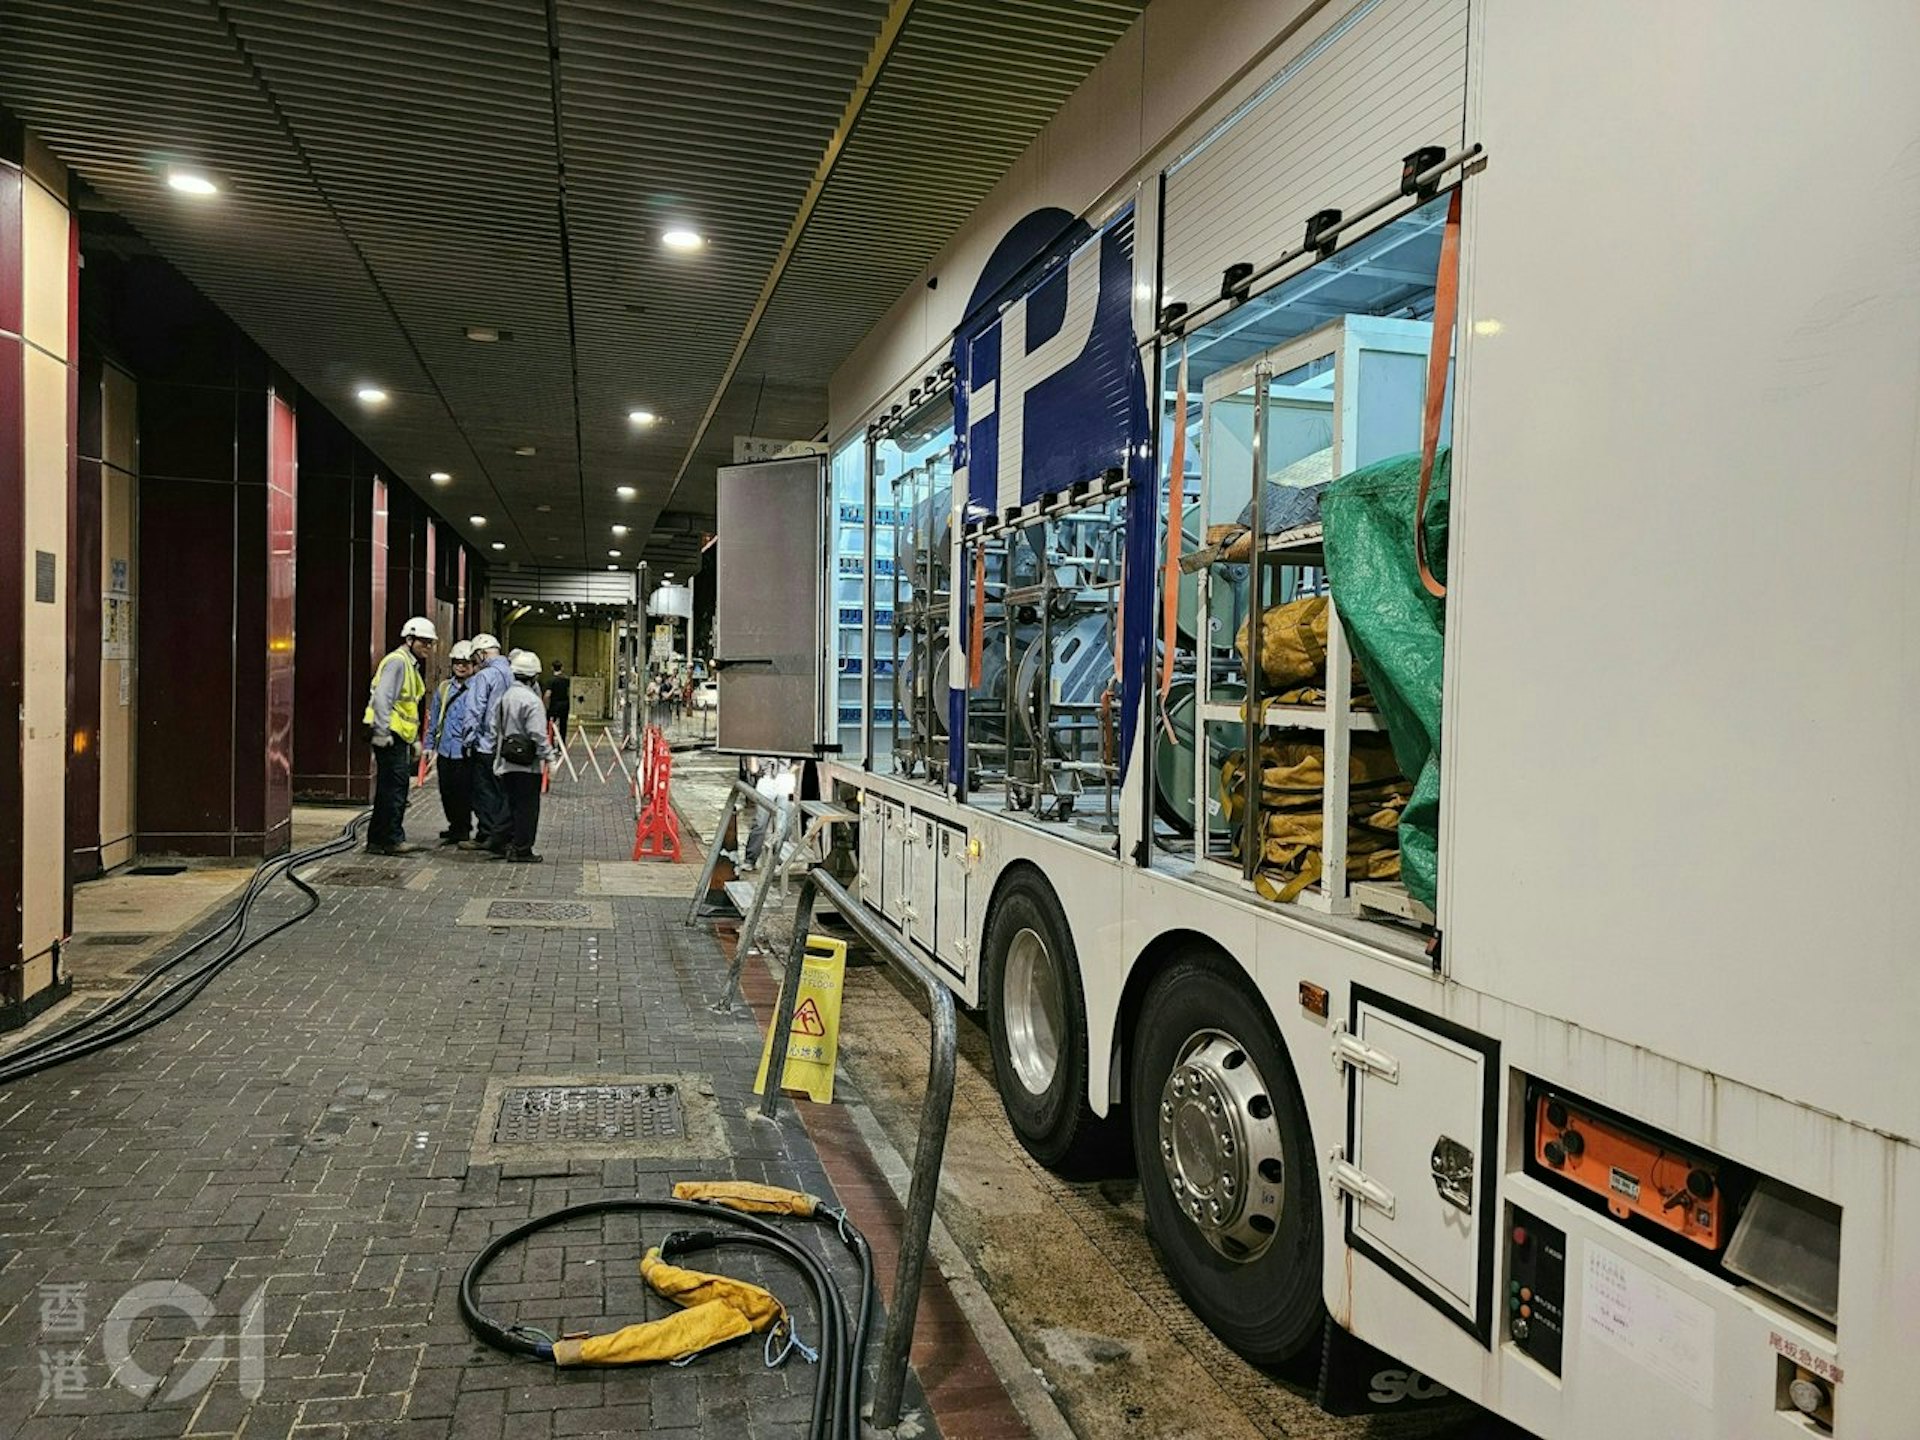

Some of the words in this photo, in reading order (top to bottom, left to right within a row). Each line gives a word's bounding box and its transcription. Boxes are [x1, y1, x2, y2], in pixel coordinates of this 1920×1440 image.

[803, 969, 831, 980] AUTION
[790, 1043, 823, 1059] 心地滑
